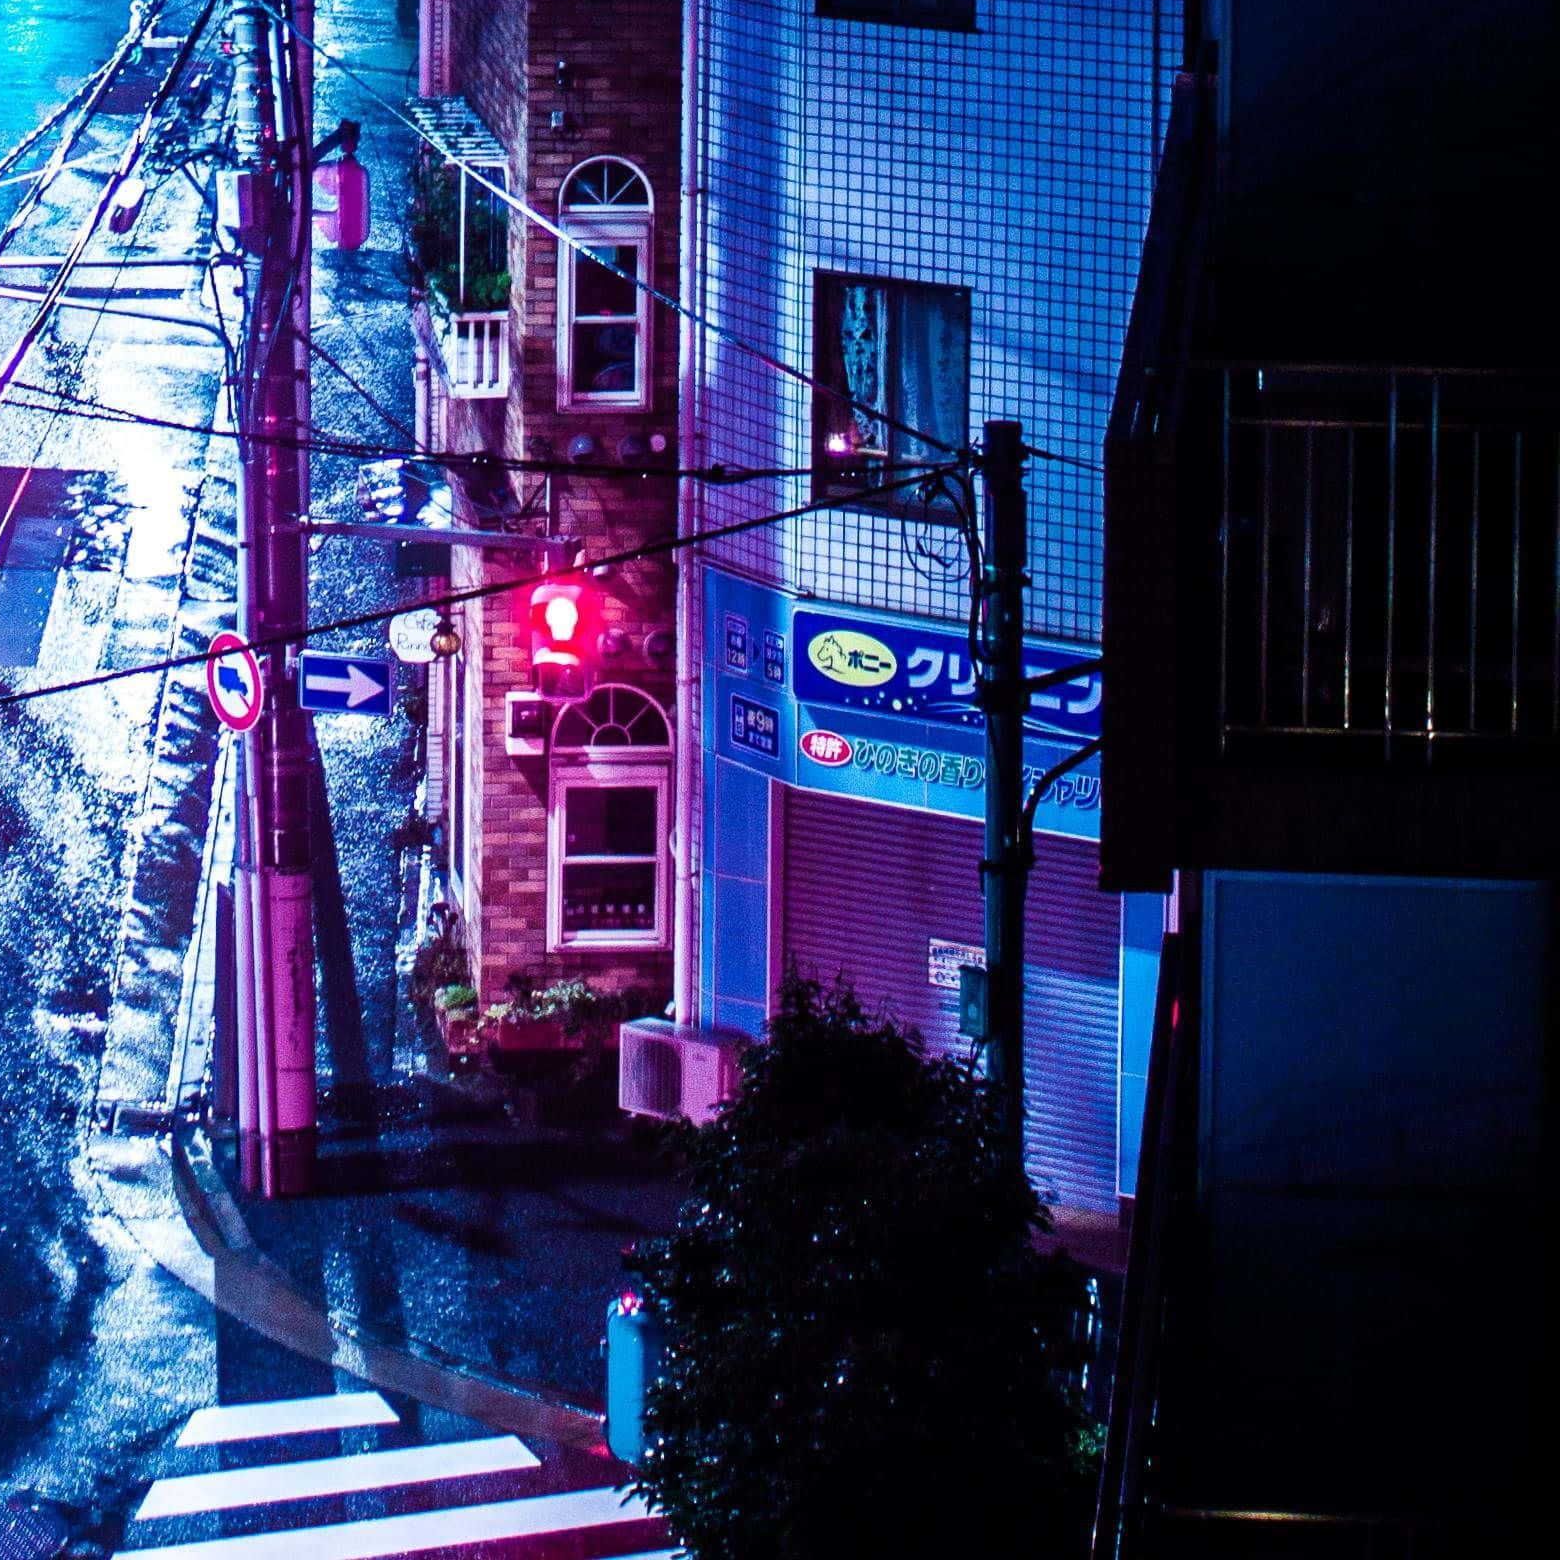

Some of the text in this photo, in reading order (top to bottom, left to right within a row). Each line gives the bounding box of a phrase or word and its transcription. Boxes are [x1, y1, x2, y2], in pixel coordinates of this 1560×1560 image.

[848, 649, 892, 673] ポニー
[907, 646, 1102, 714] クリニン
[810, 734, 844, 761] 特許
[853, 738, 985, 788] ひのきの香り
